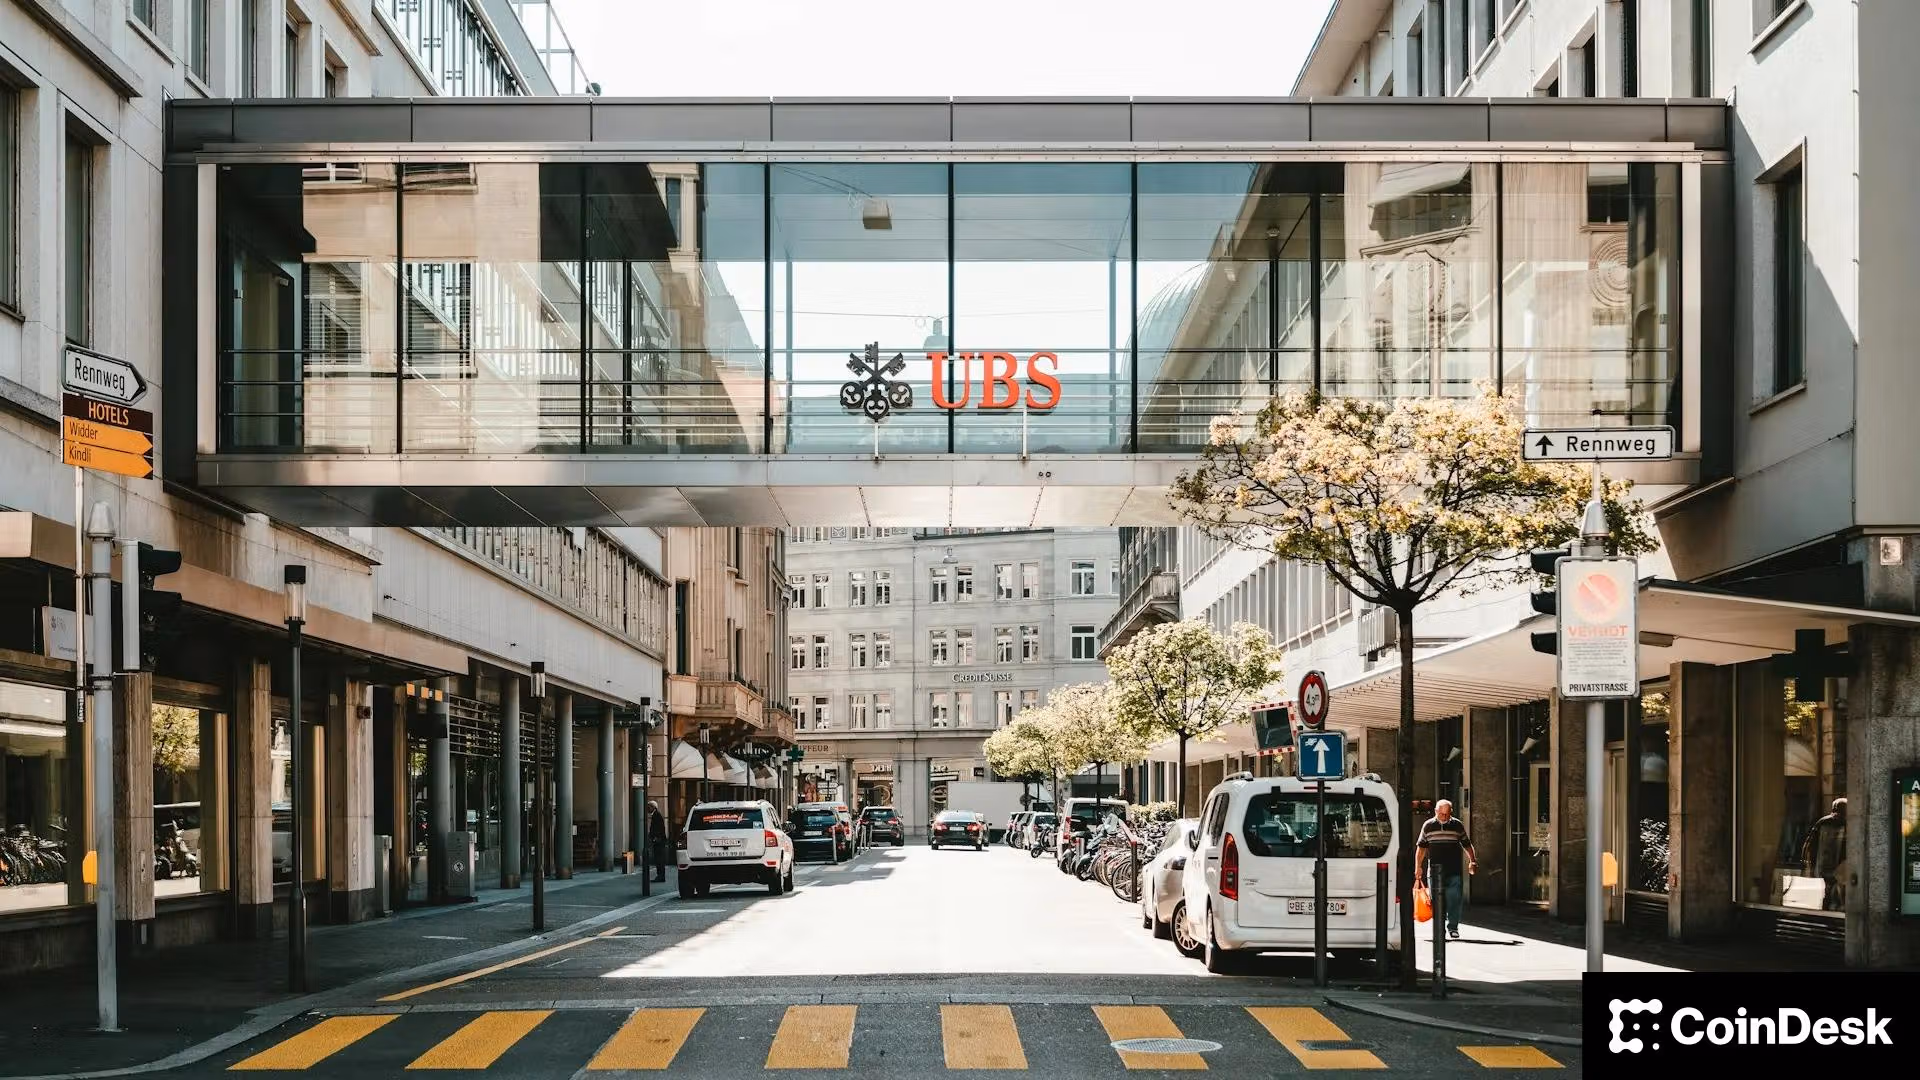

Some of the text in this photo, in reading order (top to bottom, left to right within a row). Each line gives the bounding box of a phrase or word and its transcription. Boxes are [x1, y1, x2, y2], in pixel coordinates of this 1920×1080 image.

[74, 357, 125, 397] Rennweg
[926, 351, 1062, 409] UBS
[88, 401, 129, 426] HOTELS
[69, 420, 98, 440] Widder
[68, 445, 92, 463] Kindli
[1566, 435, 1656, 455] Rennweg
[1569, 683, 1629, 693] PRIVATSTRASSE
